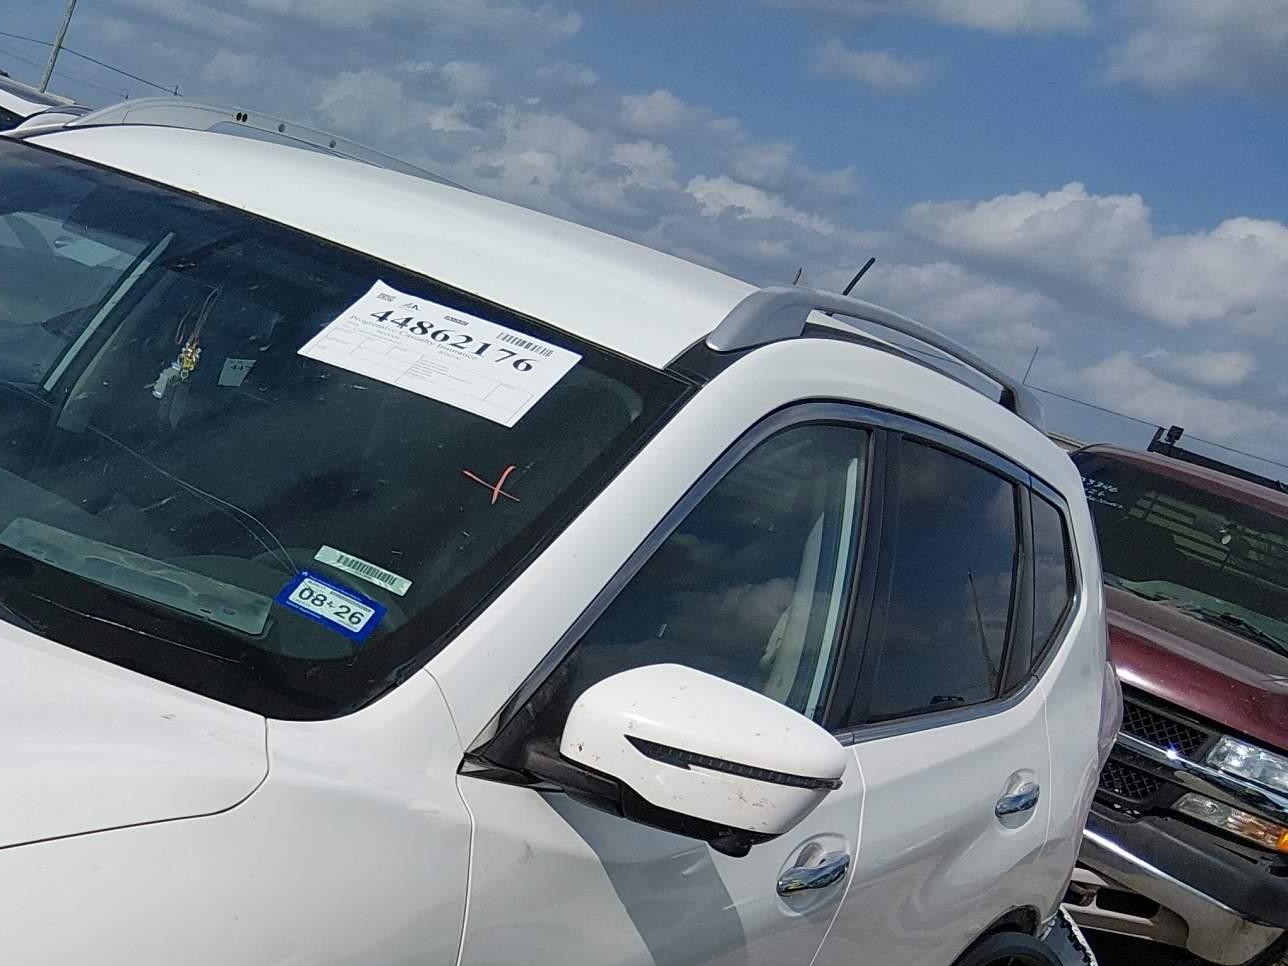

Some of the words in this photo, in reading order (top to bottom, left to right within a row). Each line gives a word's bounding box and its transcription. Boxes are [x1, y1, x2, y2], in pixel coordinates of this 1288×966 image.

[369, 310, 537, 372] 44862176
[298, 587, 328, 607] 08
[334, 604, 365, 625] 26
